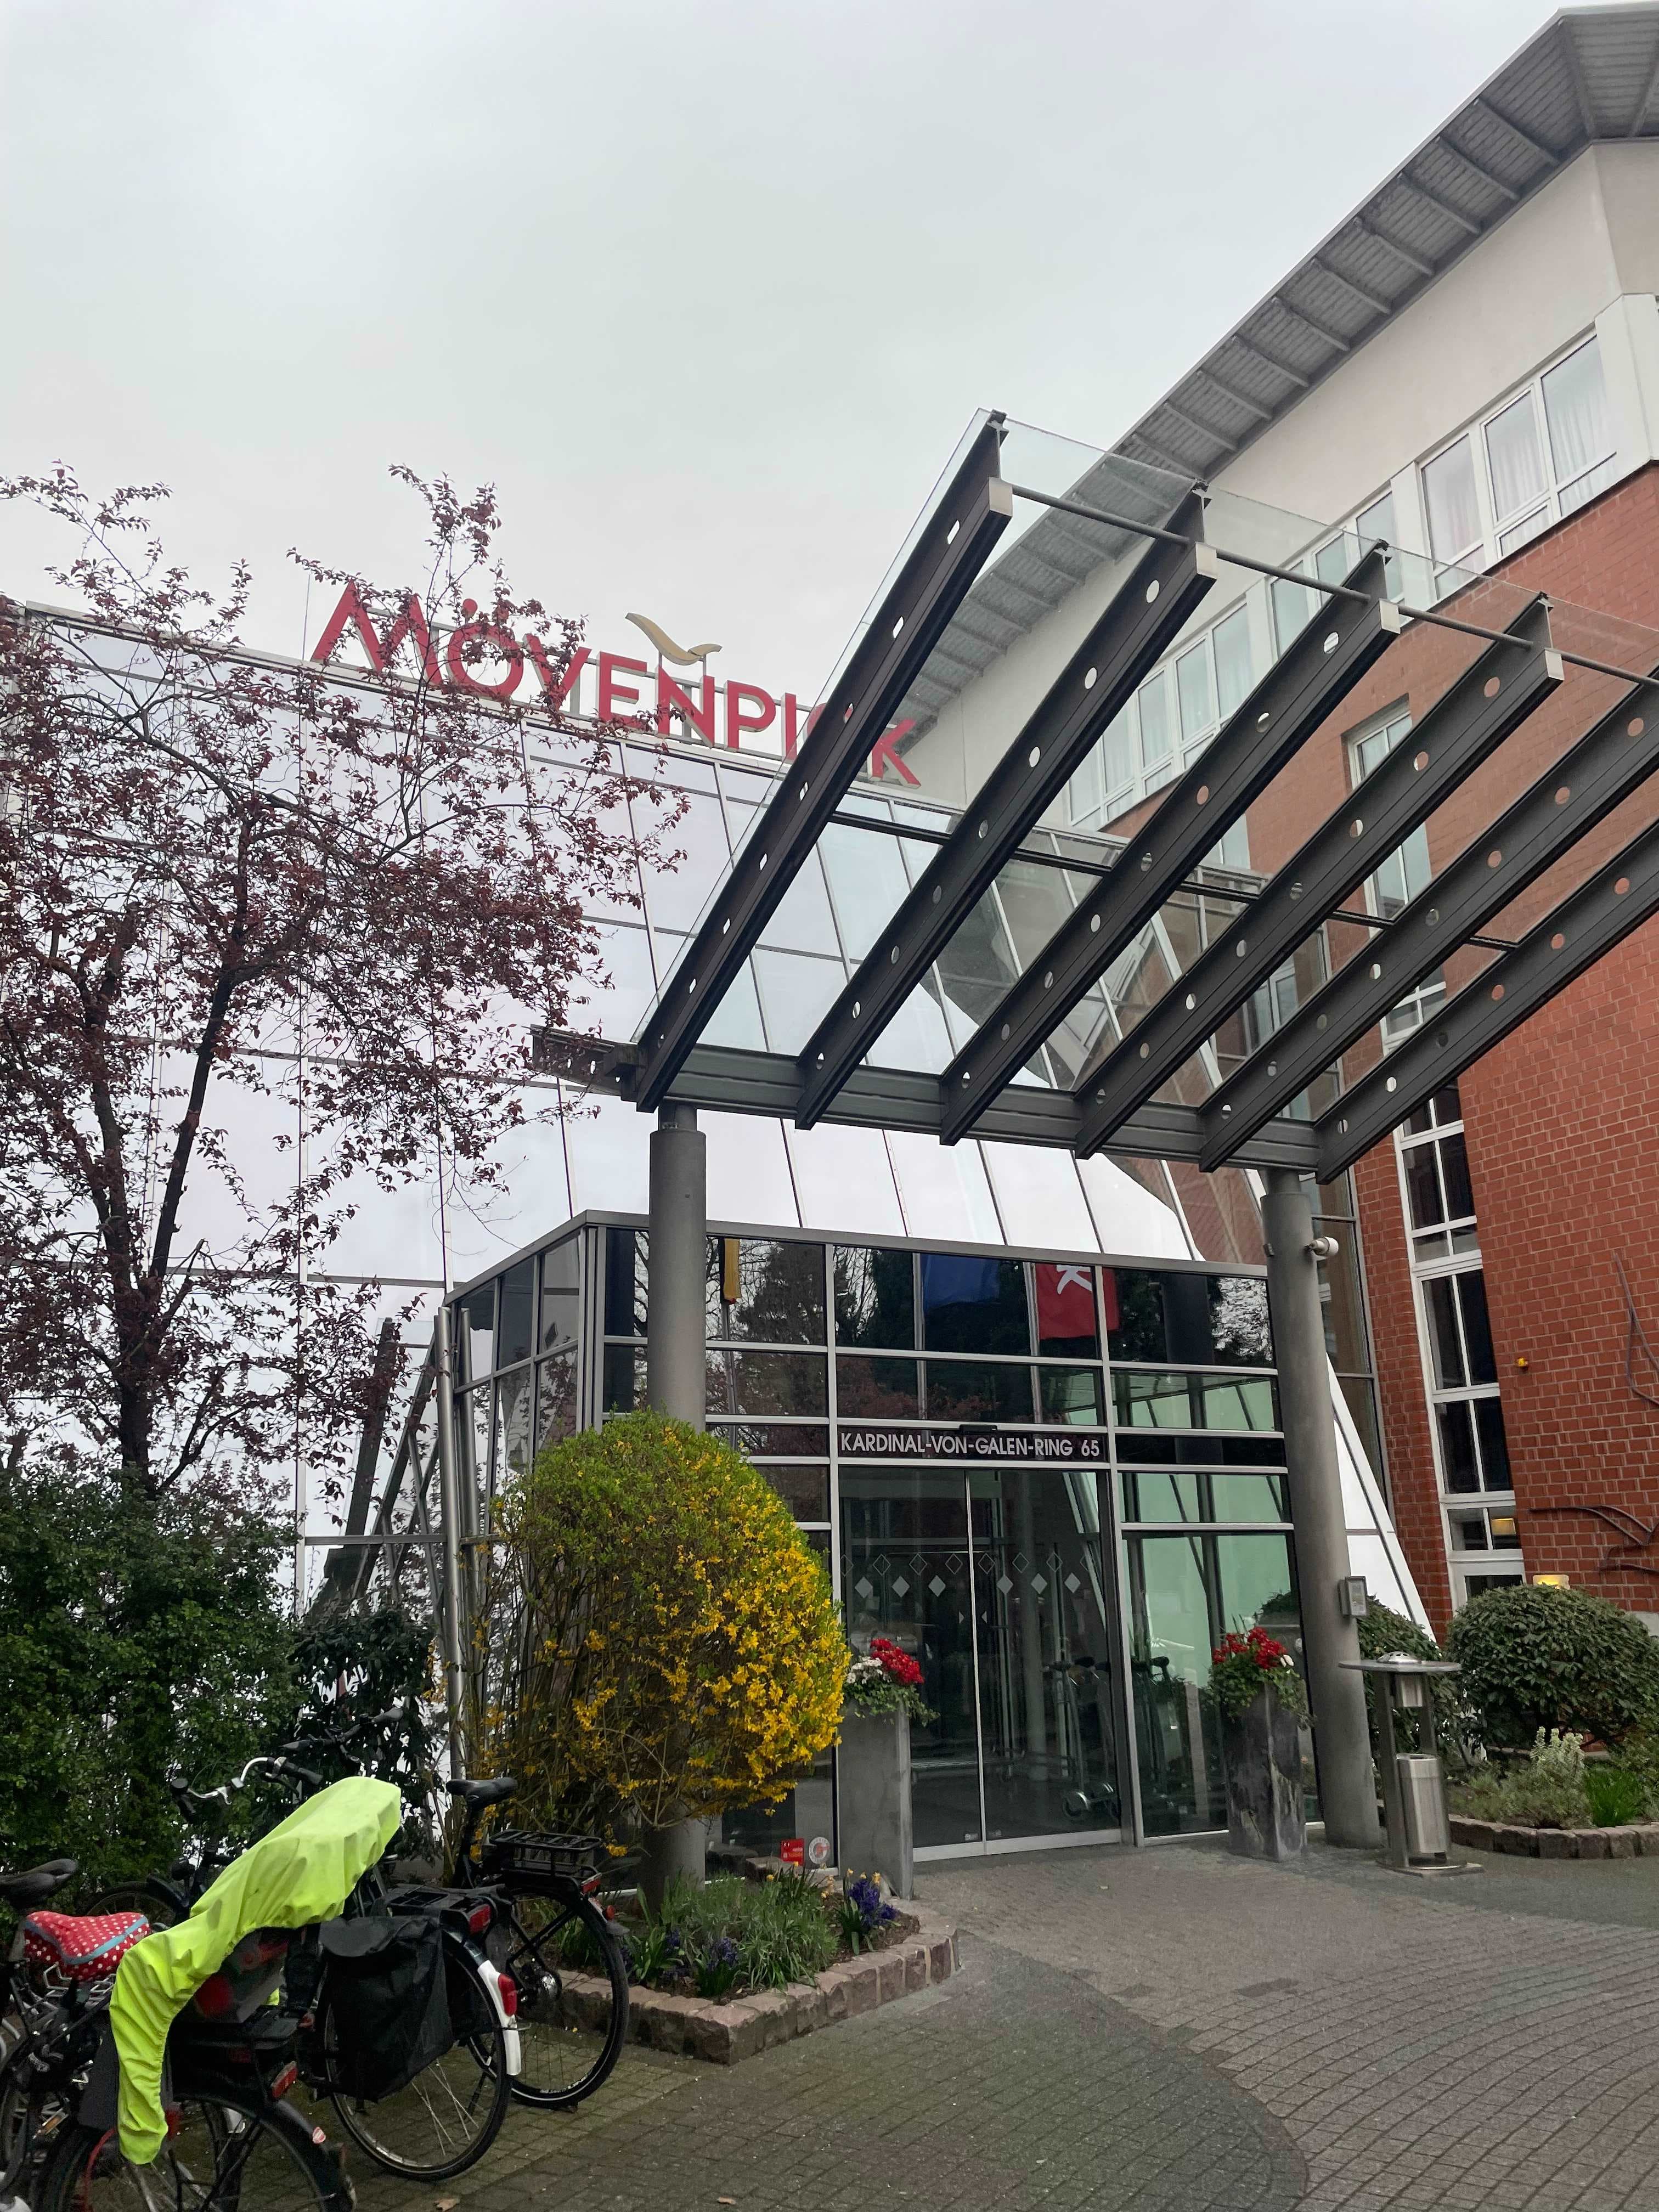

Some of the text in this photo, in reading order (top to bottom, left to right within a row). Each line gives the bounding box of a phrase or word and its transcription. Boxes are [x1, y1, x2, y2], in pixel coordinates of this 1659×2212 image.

[311, 578, 922, 788] MÖVENPIK
[841, 1432, 1100, 1457] KARDINAL-VON-GALEN-RING 65
